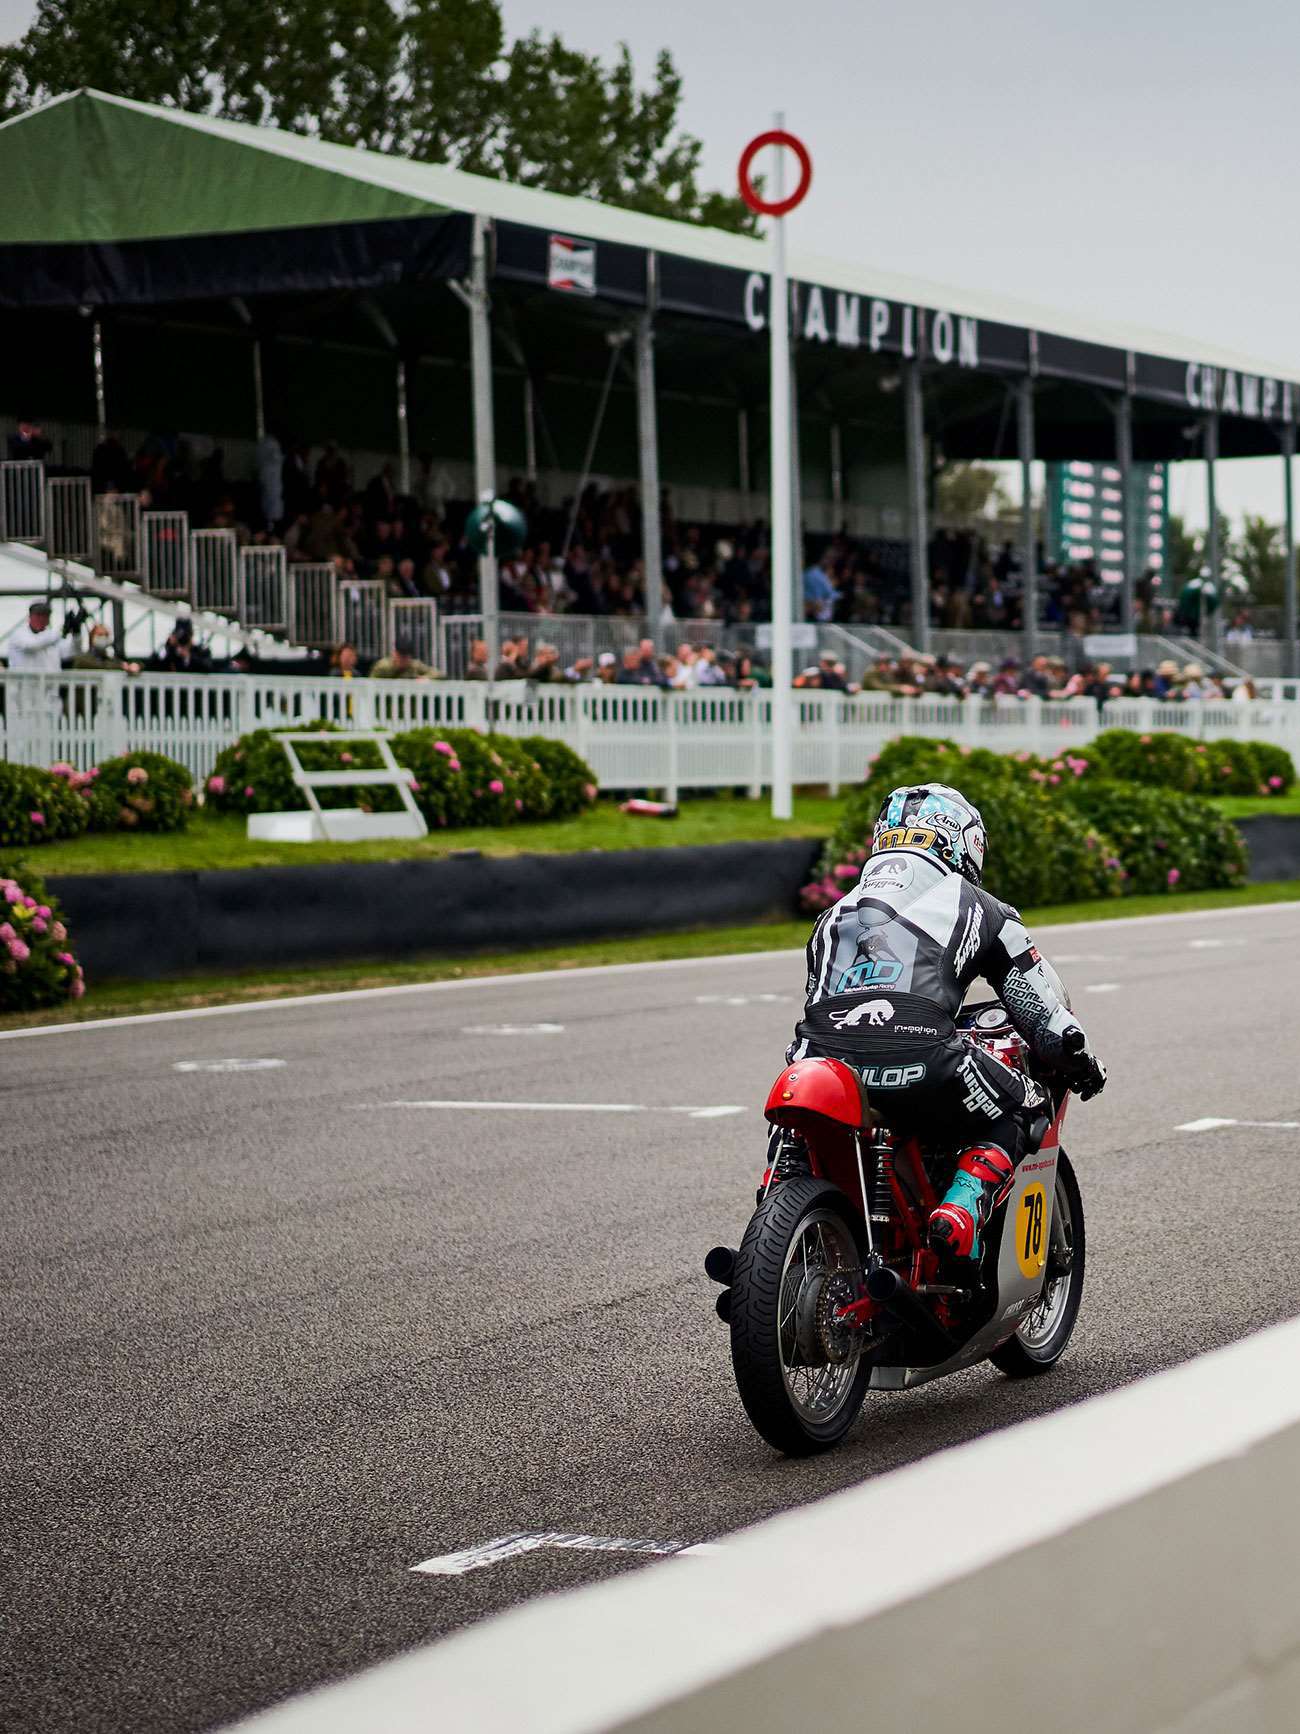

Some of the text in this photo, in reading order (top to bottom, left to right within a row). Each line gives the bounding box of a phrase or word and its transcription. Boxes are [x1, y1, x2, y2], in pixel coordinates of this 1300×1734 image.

[744, 273, 979, 368] CAMPION
[836, 960, 904, 993] MD
[1024, 1191, 1043, 1260] 78
